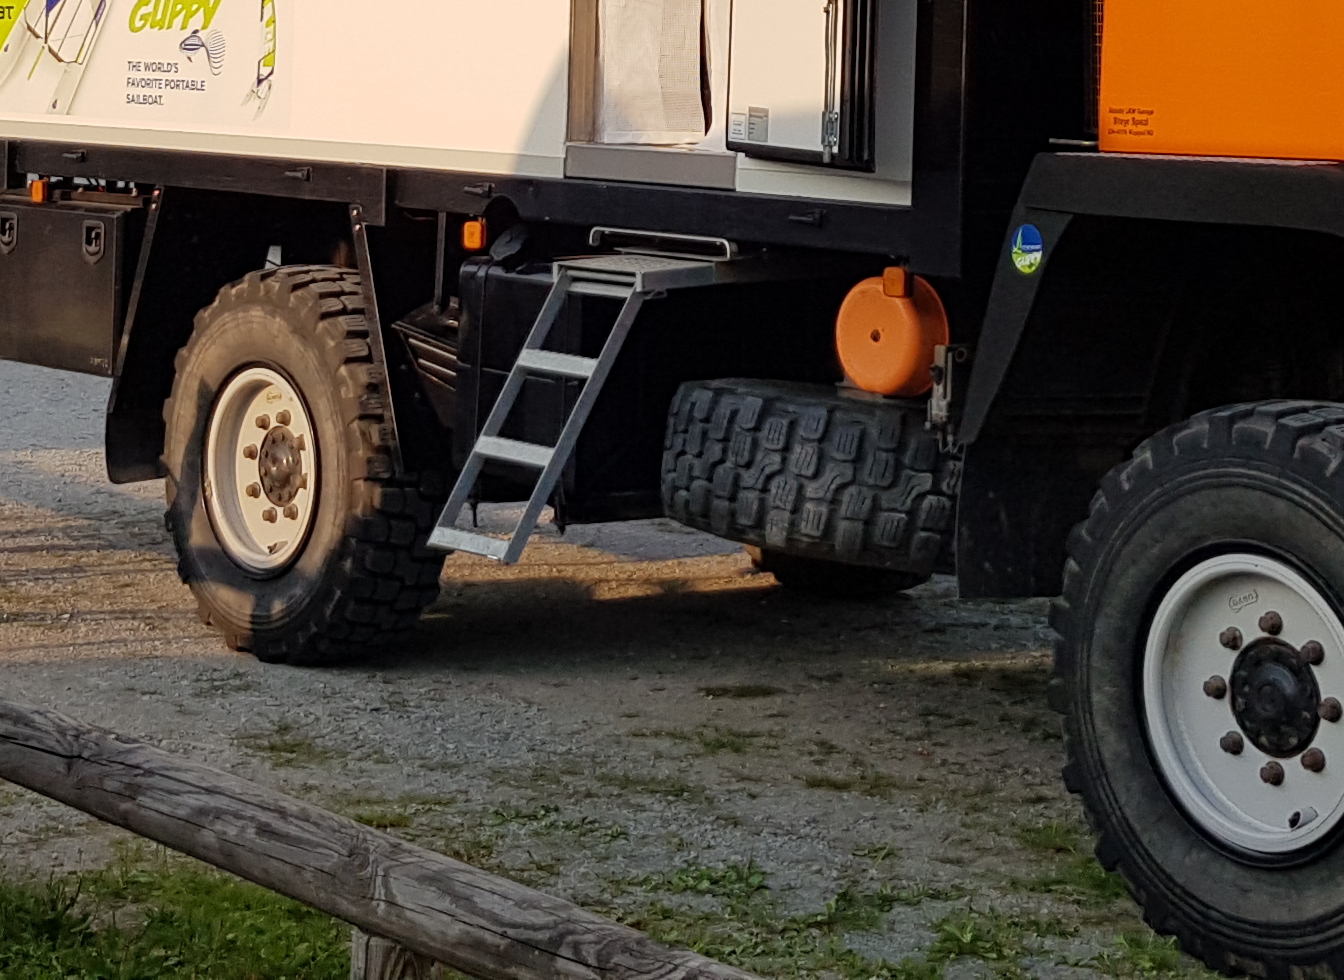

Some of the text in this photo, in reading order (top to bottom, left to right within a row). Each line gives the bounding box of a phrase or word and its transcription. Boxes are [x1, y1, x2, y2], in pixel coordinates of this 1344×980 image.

[127, 61, 179, 73] THE WORLD'S
[126, 77, 206, 91] FAVORITE PORTABLE
